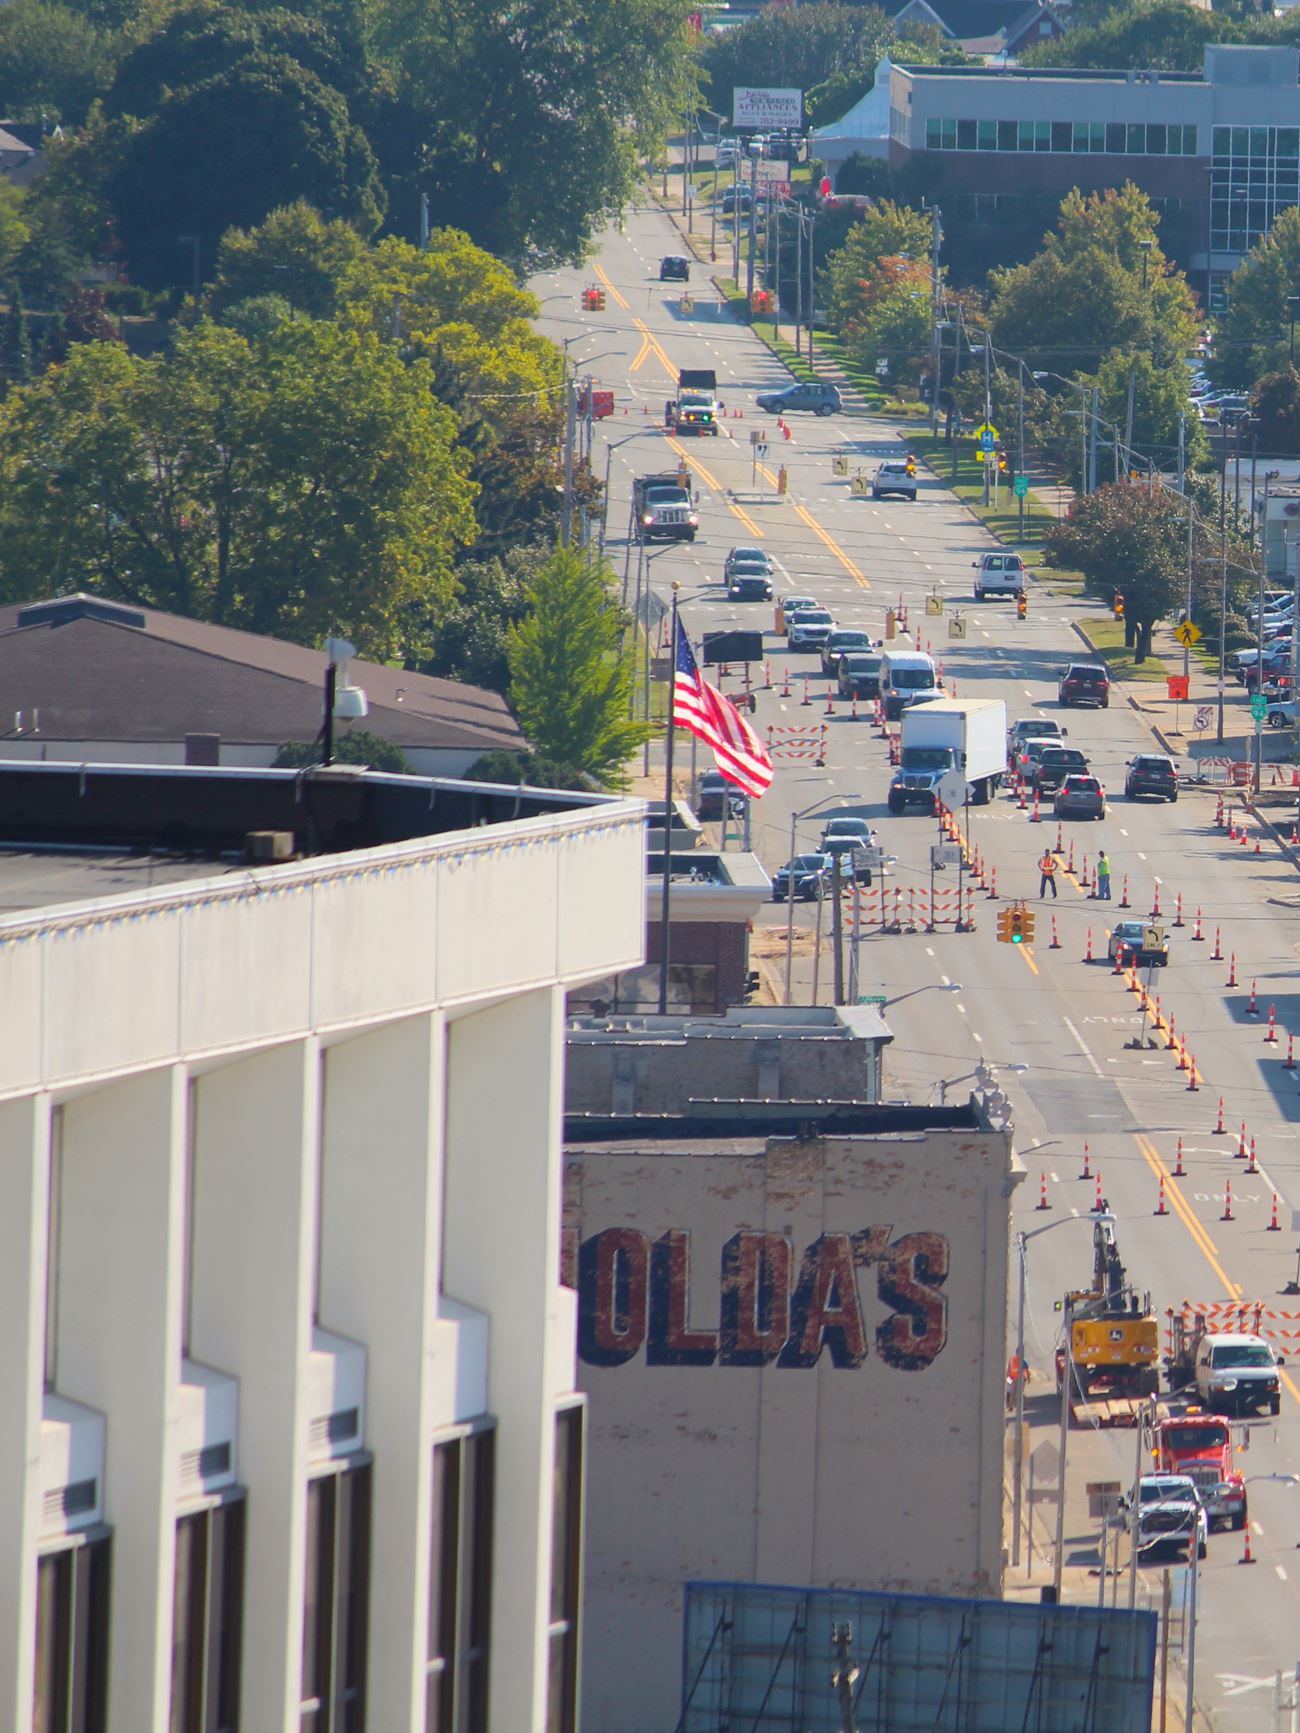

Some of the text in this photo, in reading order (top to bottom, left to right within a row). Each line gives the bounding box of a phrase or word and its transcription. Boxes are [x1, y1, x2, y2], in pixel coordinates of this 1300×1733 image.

[738, 103, 798, 111] APPLIANCES
[1252, 709, 1264, 718] 94
[1193, 1193, 1260, 1202] ONLY
[561, 1224, 951, 1371] OLDA'S
